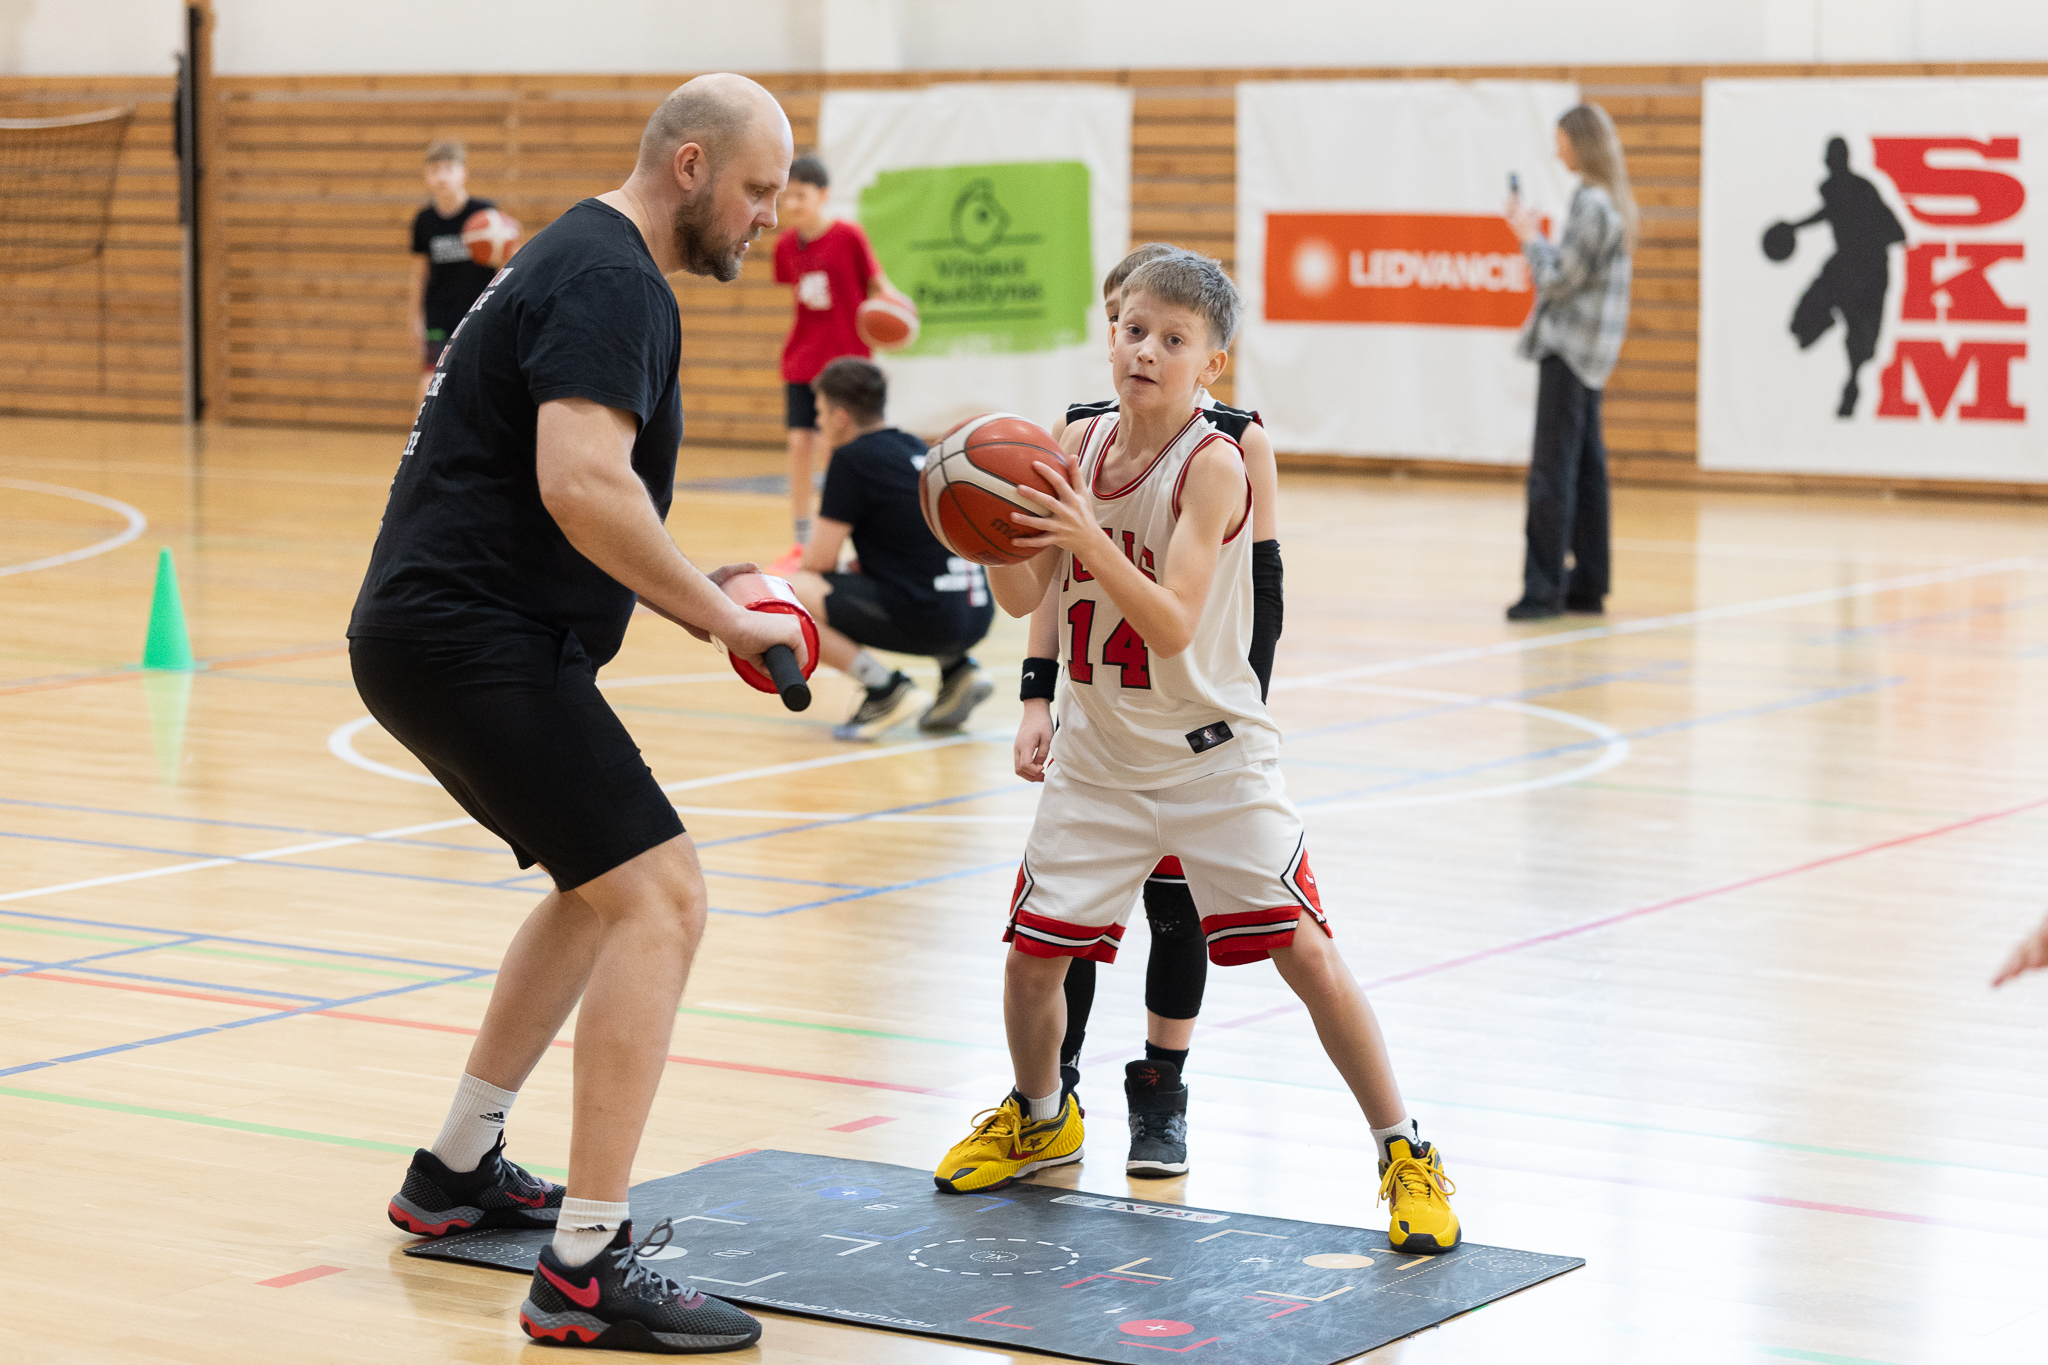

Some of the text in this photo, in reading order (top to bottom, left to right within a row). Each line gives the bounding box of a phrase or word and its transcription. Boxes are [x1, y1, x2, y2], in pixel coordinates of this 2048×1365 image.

[1349, 249, 1528, 293] LEDVANCE
[1869, 137, 2027, 421] SKM
[1068, 599, 1152, 690] 14
[730, 1294, 938, 1328] FOOTWORK GRIPMAT
